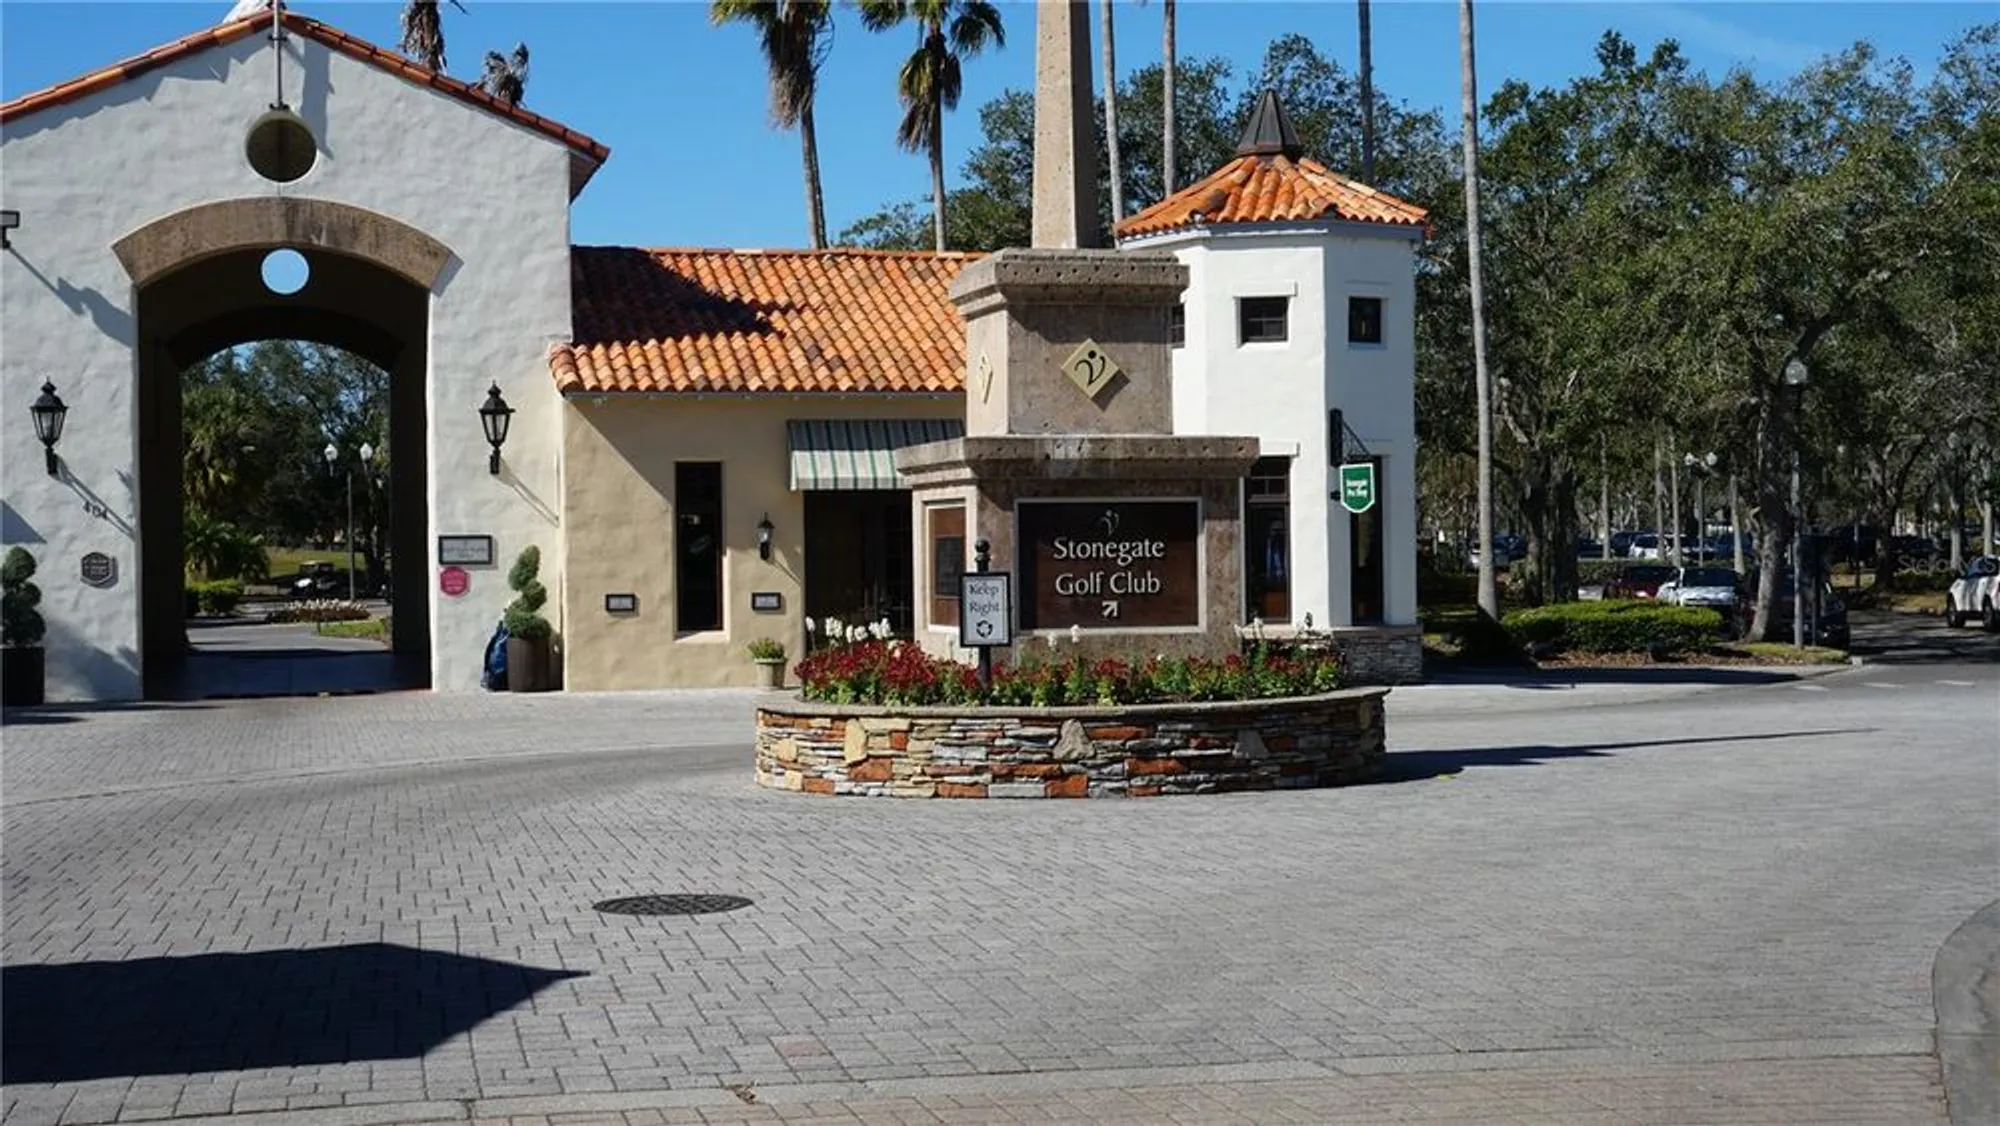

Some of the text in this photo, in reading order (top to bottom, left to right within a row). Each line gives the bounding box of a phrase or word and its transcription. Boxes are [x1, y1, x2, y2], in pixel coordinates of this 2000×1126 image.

[1053, 537, 1165, 566] Stonegate
[968, 583, 999, 599] Keep
[1055, 570, 1161, 595] Golf Club
[969, 601, 999, 616] Right
